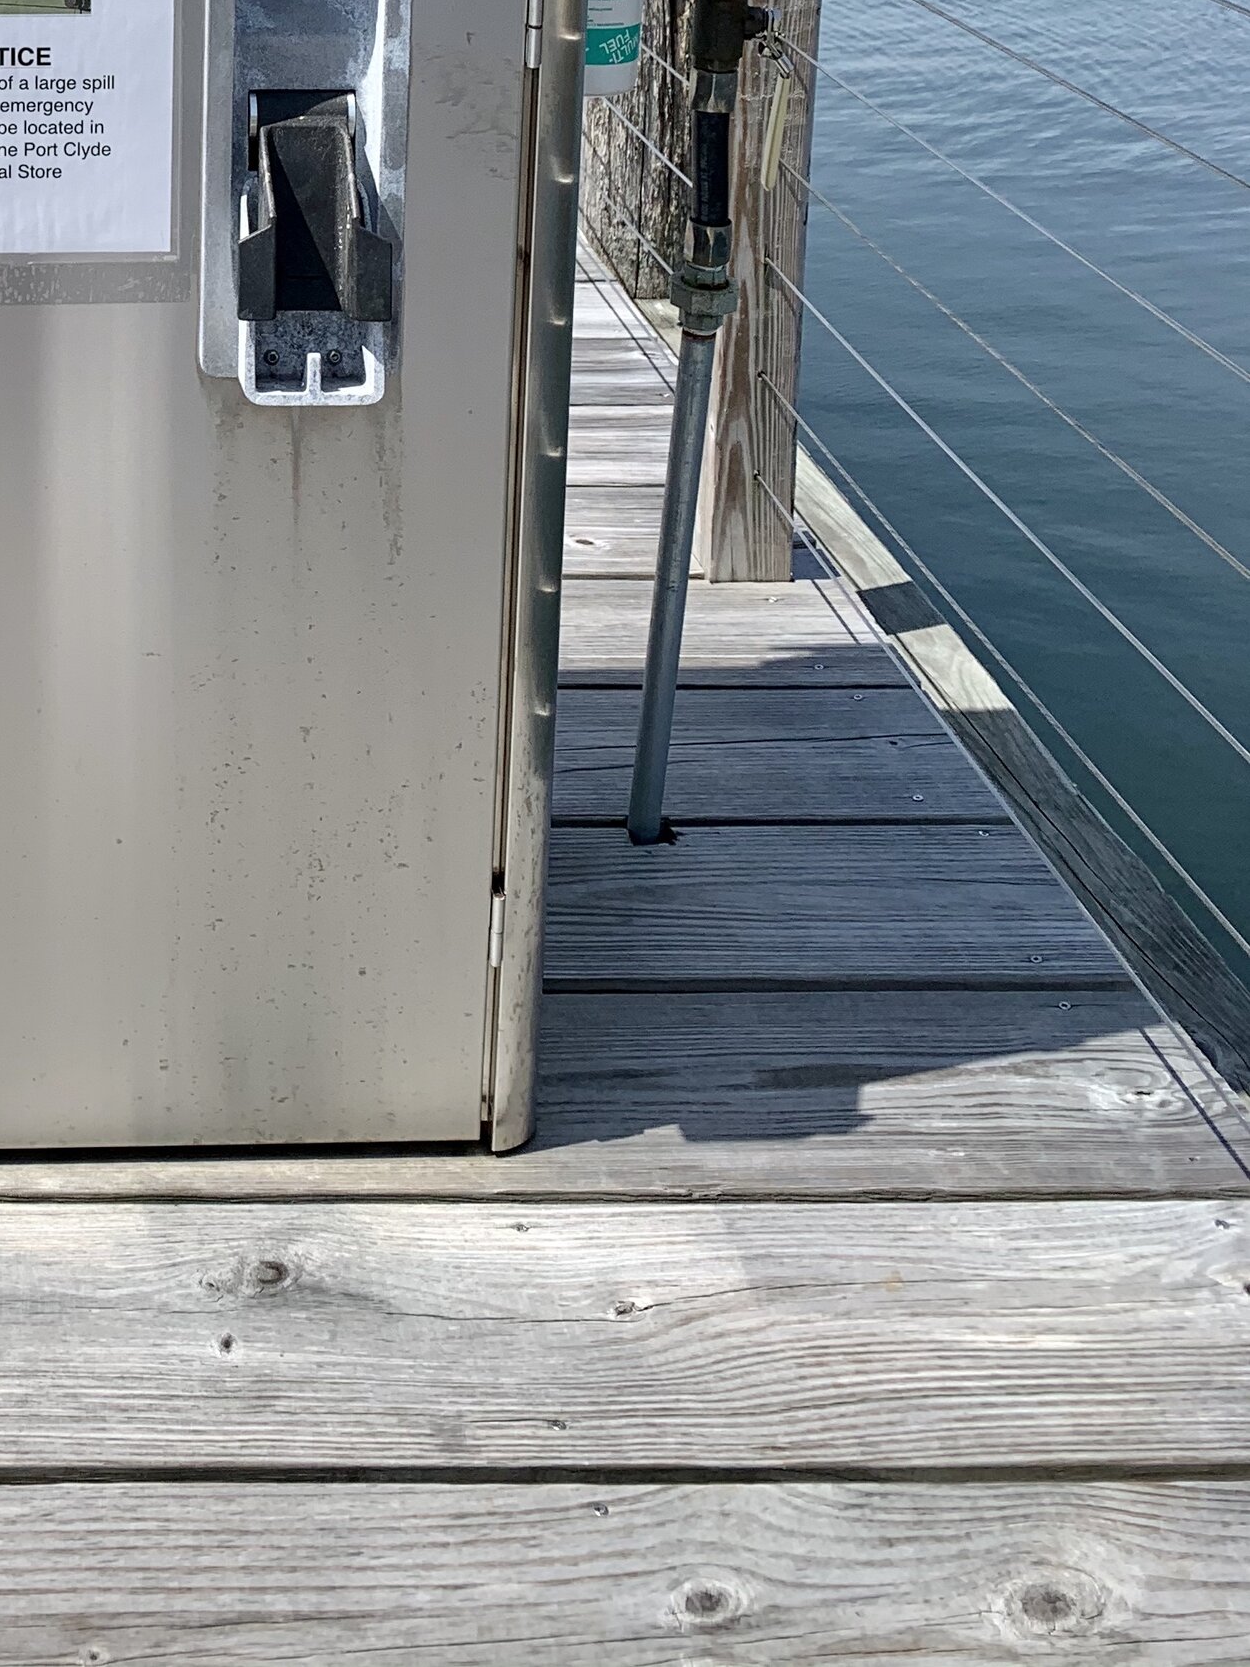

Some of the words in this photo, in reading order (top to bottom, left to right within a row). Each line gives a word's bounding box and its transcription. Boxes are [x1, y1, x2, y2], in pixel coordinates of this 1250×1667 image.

[599, 29, 630, 54] FUEL
[18, 80, 29, 91] a
[34, 76, 77, 94] large
[82, 76, 115, 94] spill
[0, 102, 94, 117] emergency
[23, 120, 84, 135] located
[90, 120, 104, 134] in
[24, 142, 58, 157] Port
[63, 142, 112, 160] Clyde
[17, 164, 62, 179] Store
